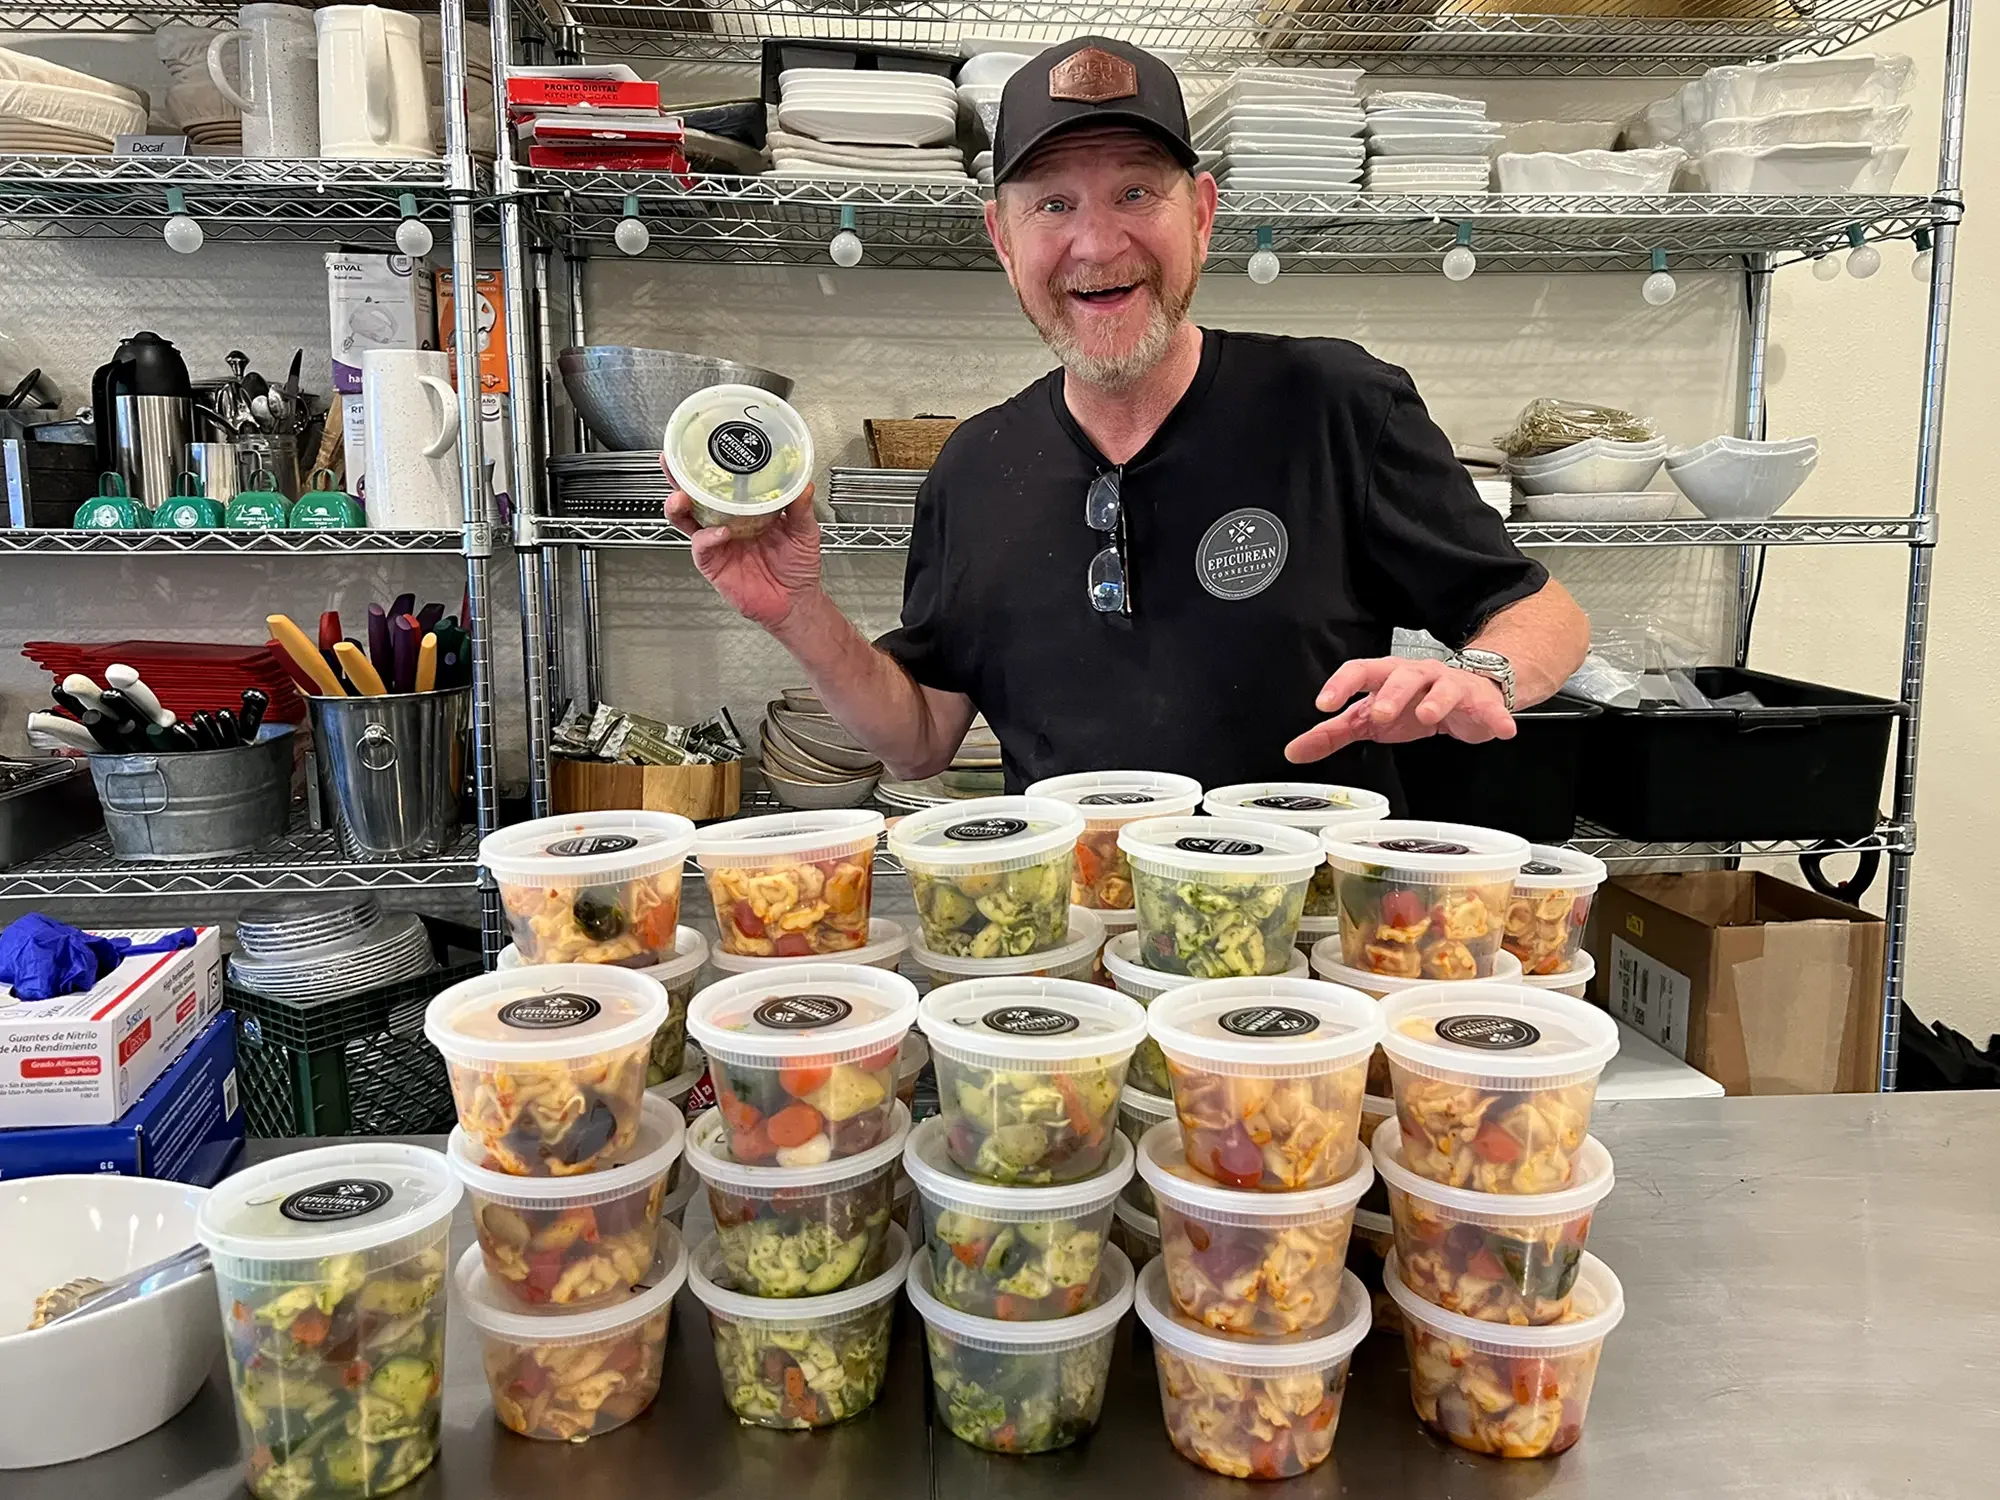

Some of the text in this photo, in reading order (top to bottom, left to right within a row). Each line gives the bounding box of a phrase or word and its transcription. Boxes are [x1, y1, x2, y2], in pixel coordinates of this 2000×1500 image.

[132, 142, 165, 152] Decaf
[721, 433, 757, 464] EPICUREAN
[1208, 546, 1276, 571] EPICUREAN
[1212, 562, 1272, 580] CONNECTION
[515, 1008, 583, 1016] EPICUREAN
[9, 1031, 98, 1043] Guantes de Nitrilo
[11, 1045, 31, 1053] Alto
[34, 1042, 98, 1052] Rendimiento
[300, 1196, 370, 1207] EPICUREAN
